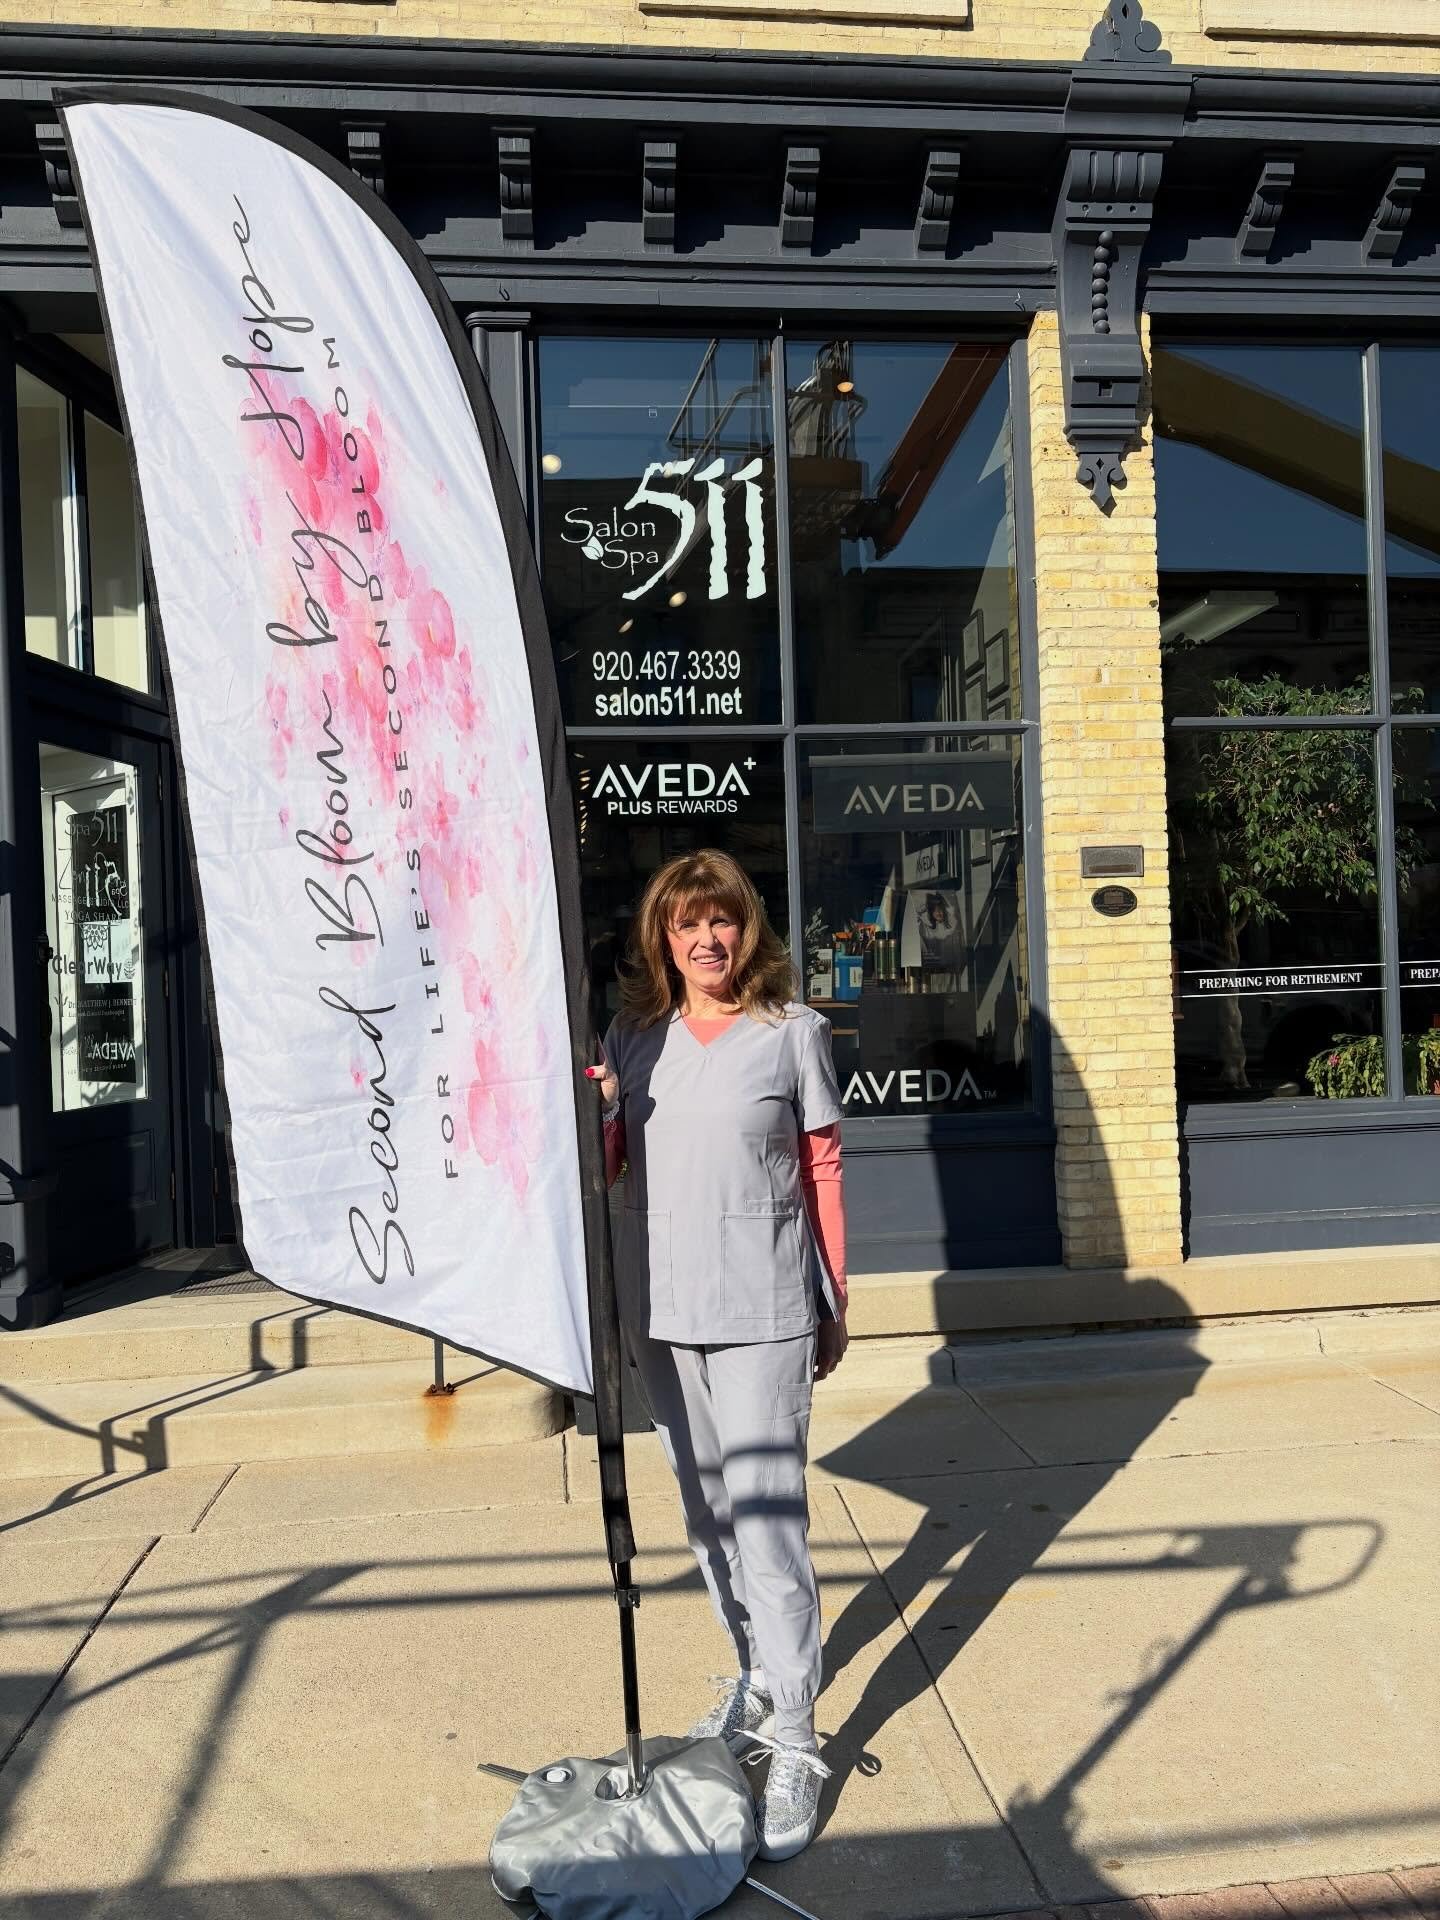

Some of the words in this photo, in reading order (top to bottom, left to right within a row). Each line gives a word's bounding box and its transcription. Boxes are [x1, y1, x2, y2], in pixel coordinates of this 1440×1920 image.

[222, 194, 314, 461] Hope
[322, 337, 373, 534] BLOOM
[561, 507, 657, 543] Salon
[622, 457, 767, 600] 511
[266, 491, 369, 647] by
[601, 539, 659, 575] Spa
[592, 650, 741, 682] 920.467.3339
[366, 576, 413, 810] SECOND
[595, 686, 743, 716] salon511.net
[607, 801, 652, 815] PLUS
[657, 799, 738, 814] REWARDS
[844, 782, 985, 815] AVEDA
[91, 810, 118, 847] 511
[296, 689, 384, 951] Bloom
[407, 848, 444, 1034] LIFE'S
[52, 954, 122, 981] ClearWay
[1199, 976, 1263, 989] PREPARING
[1265, 974, 1288, 987] FOR
[1290, 972, 1363, 985] RETIREMENT
[841, 1068, 982, 1104] AVEDA
[319, 986, 415, 1286] Second
[437, 1074, 459, 1179] FOR
